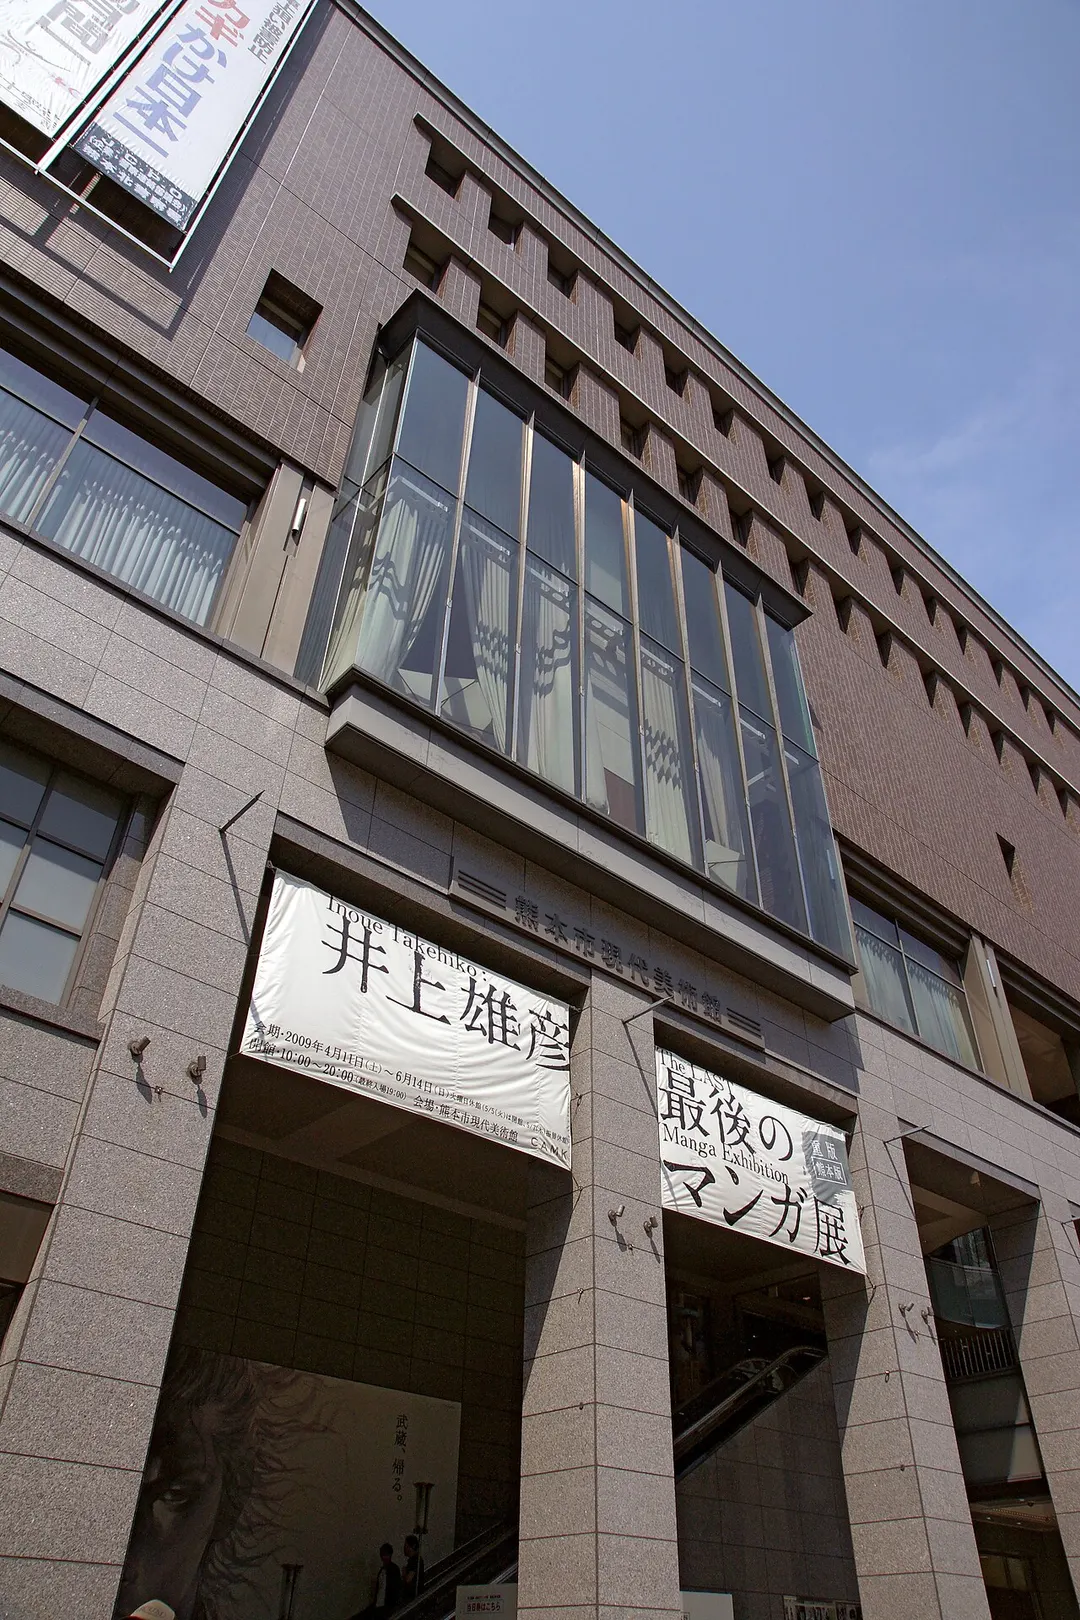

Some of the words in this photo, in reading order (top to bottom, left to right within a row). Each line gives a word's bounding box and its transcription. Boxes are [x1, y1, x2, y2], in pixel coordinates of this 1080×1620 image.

[325, 895, 383, 935] Inoue
[515, 895, 722, 1025] 熊本市現代美術館
[321, 914, 570, 1072] 井上雄彦
[658, 1048, 685, 1075] The
[659, 1067, 794, 1162] 最後の
[662, 1123, 717, 1159] Manga
[722, 1144, 790, 1185] Exhibition
[663, 1159, 852, 1266] マンガ展
[392, 1413, 408, 1501] 武蔵、帰る。
